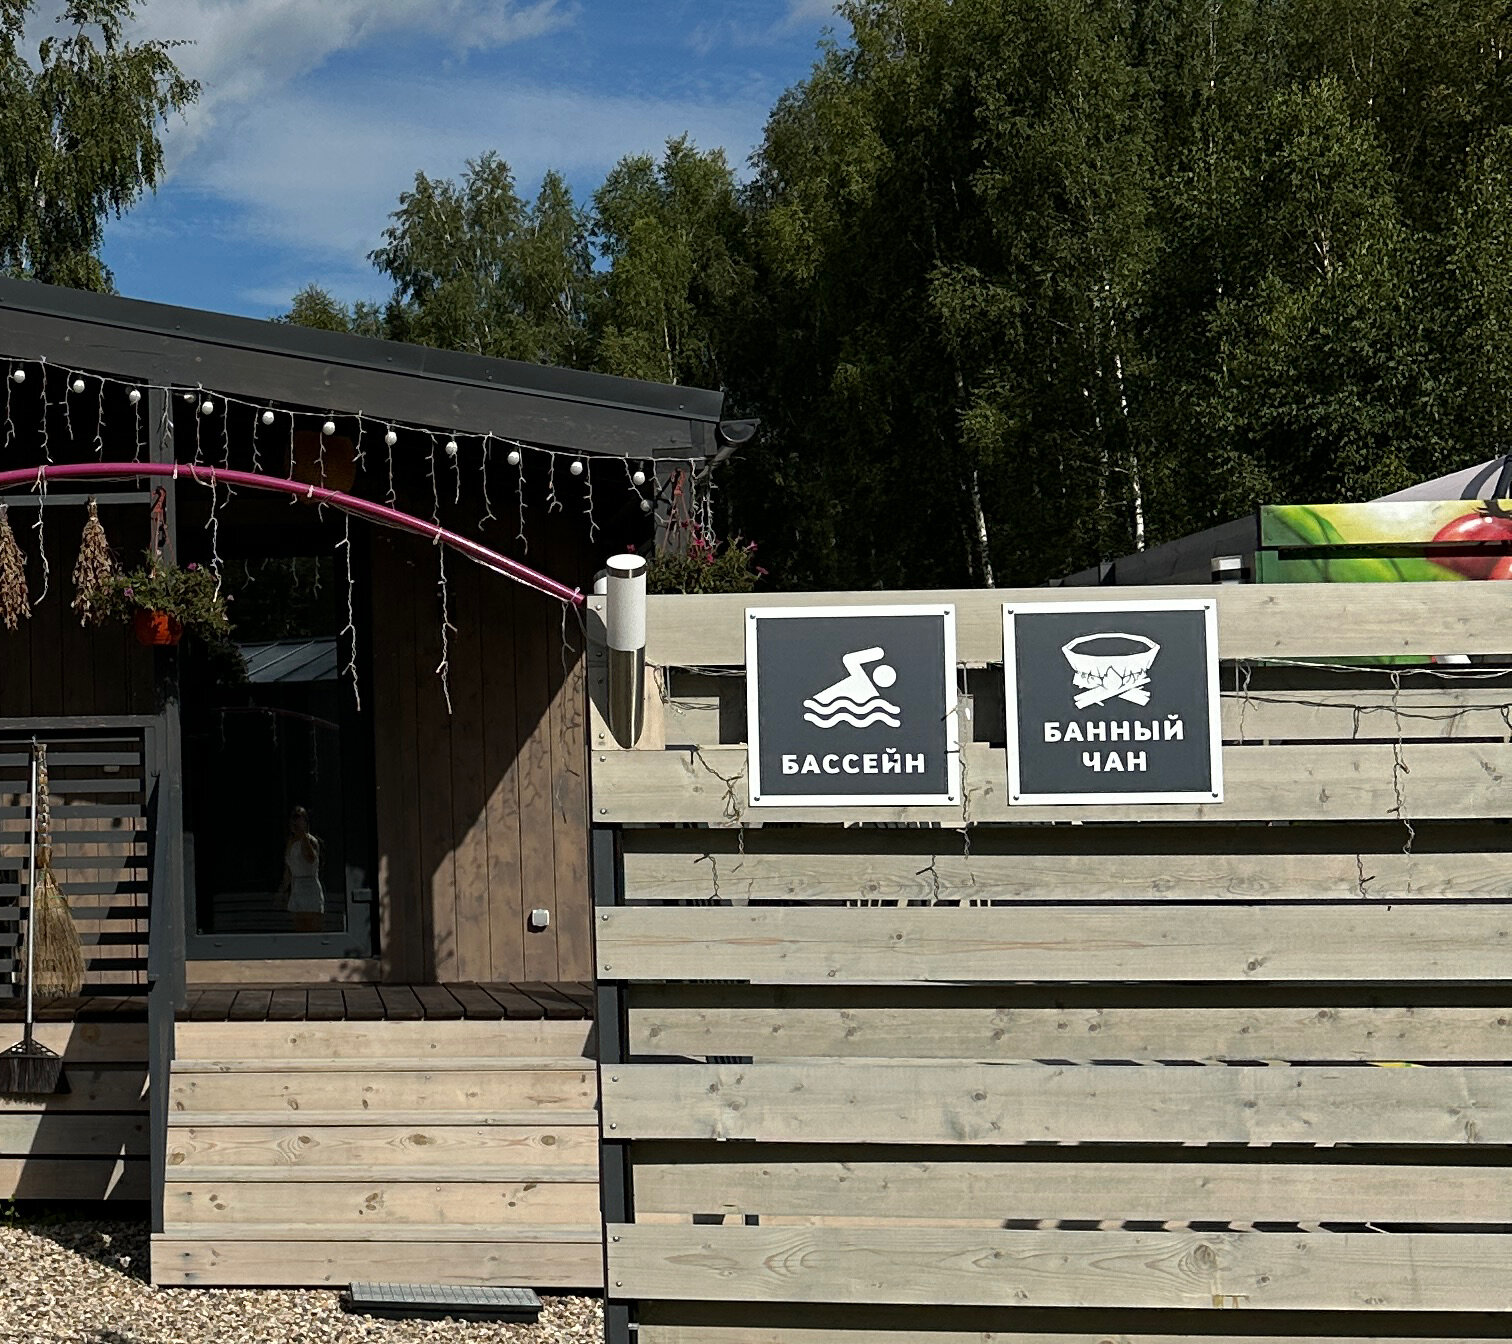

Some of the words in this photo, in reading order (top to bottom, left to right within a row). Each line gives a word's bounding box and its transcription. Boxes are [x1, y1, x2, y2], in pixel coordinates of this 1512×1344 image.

[1044, 714, 1184, 742] БАННЫЙ
[781, 747, 925, 775] БАССЕЙН
[1082, 751, 1147, 772] ЧАН
